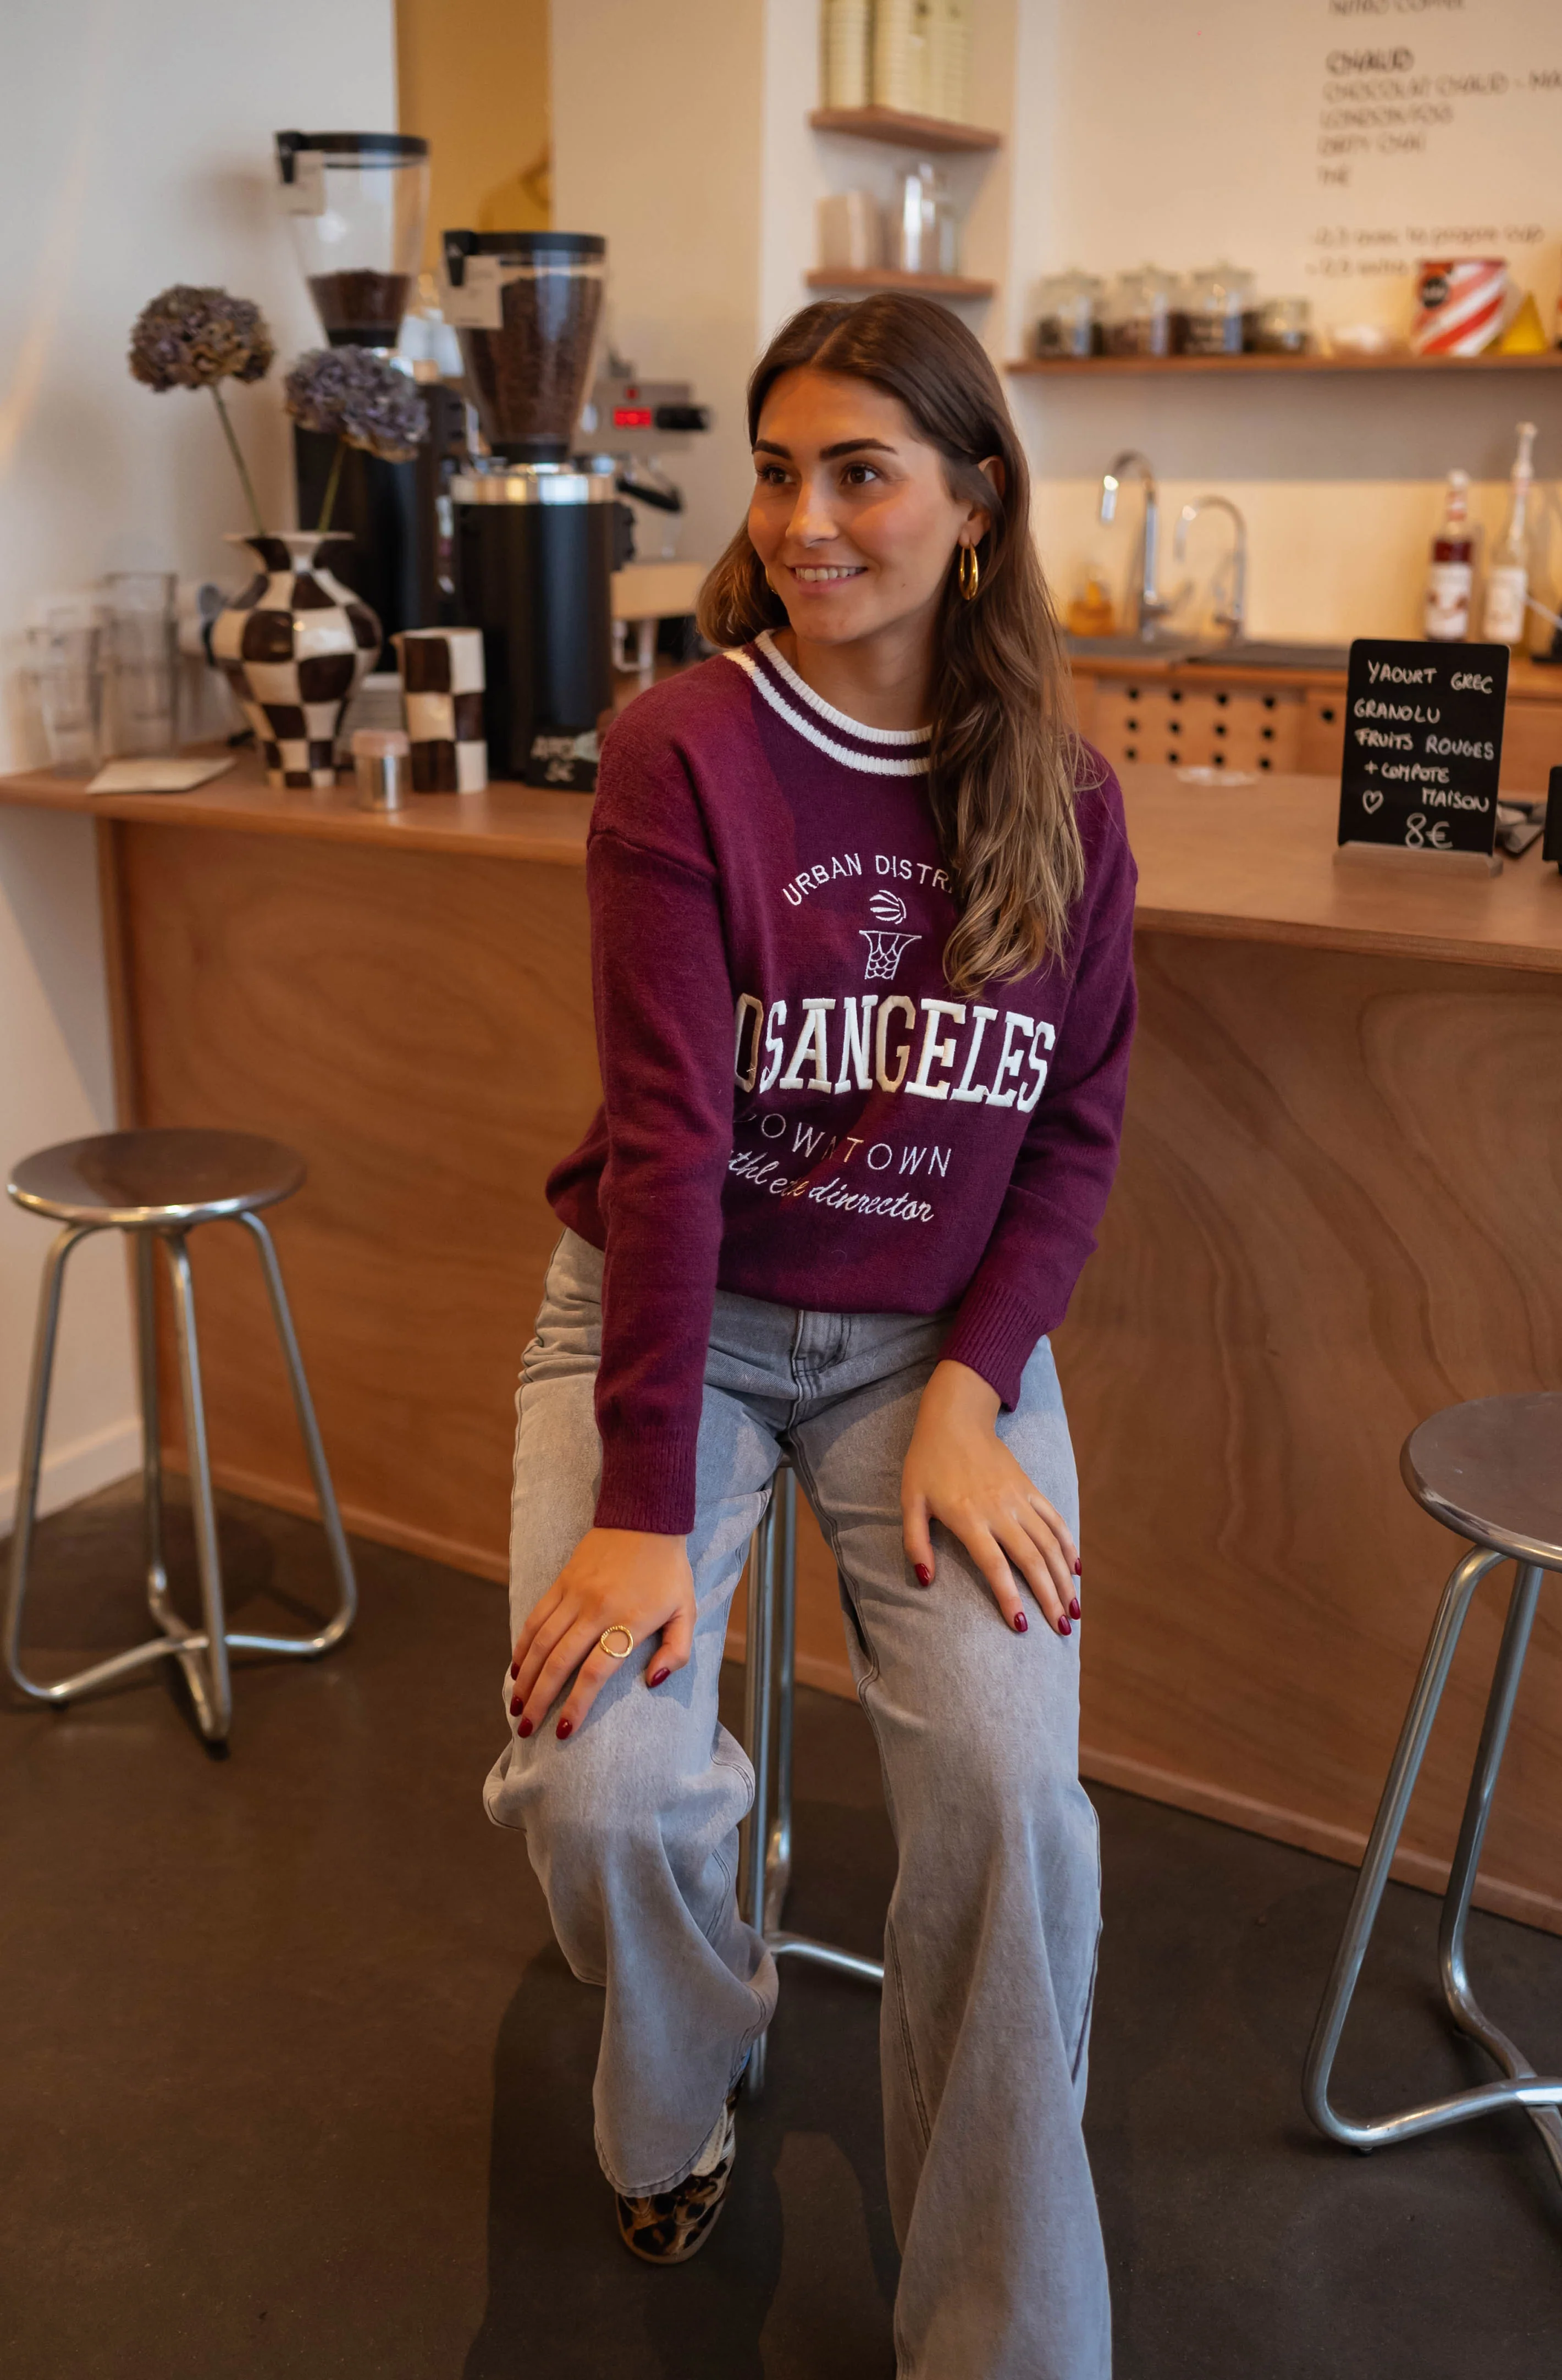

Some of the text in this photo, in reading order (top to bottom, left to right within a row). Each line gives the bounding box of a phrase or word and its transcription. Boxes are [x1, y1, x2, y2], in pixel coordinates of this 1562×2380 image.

[1326, 47, 1414, 74] CHAUD
[1435, 71, 1509, 96] CHAUD
[1368, 660, 1493, 694] YAOURT GREC
[1425, 733, 1494, 761] ROUGES
[1381, 762, 1450, 783] COMPOTE
[1405, 813, 1453, 849] 8€
[782, 853, 952, 905] URBAN DISTR
[734, 992, 1056, 1113] OSANGELES
[734, 1113, 952, 1178] OWNTOWN
